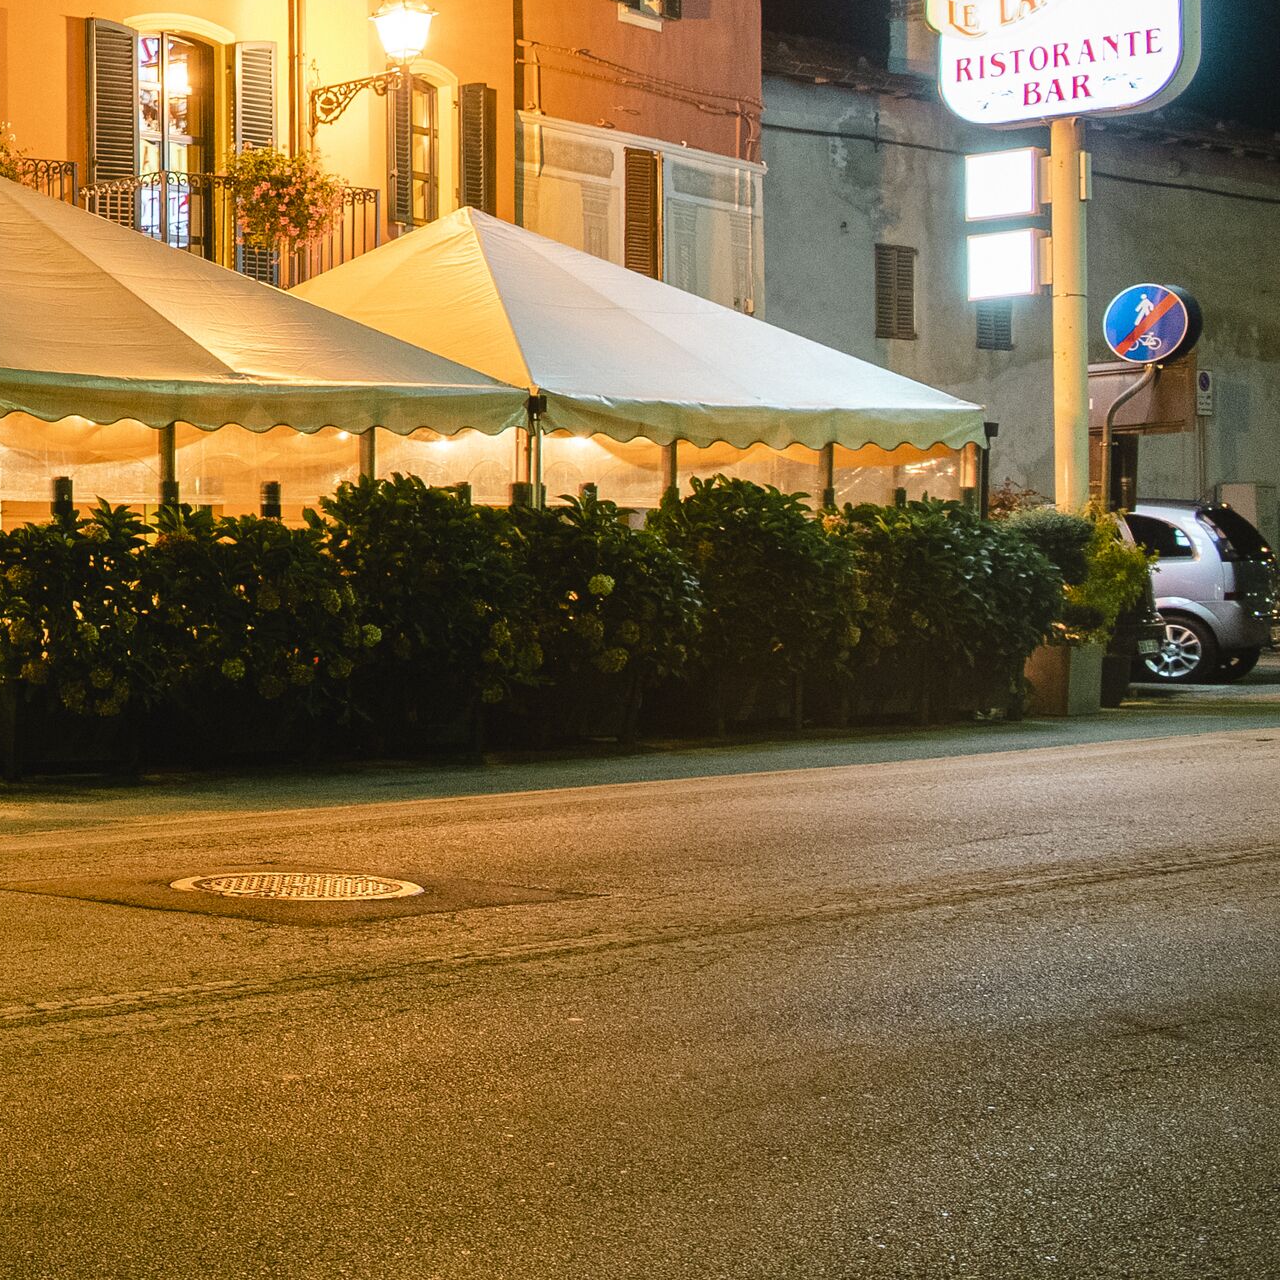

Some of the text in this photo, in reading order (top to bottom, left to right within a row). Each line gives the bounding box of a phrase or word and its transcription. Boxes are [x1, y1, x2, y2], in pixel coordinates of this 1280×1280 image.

[948, 0, 988, 37] LE
[955, 27, 1163, 83] RISTORANTE
[1023, 74, 1093, 107] BAR
